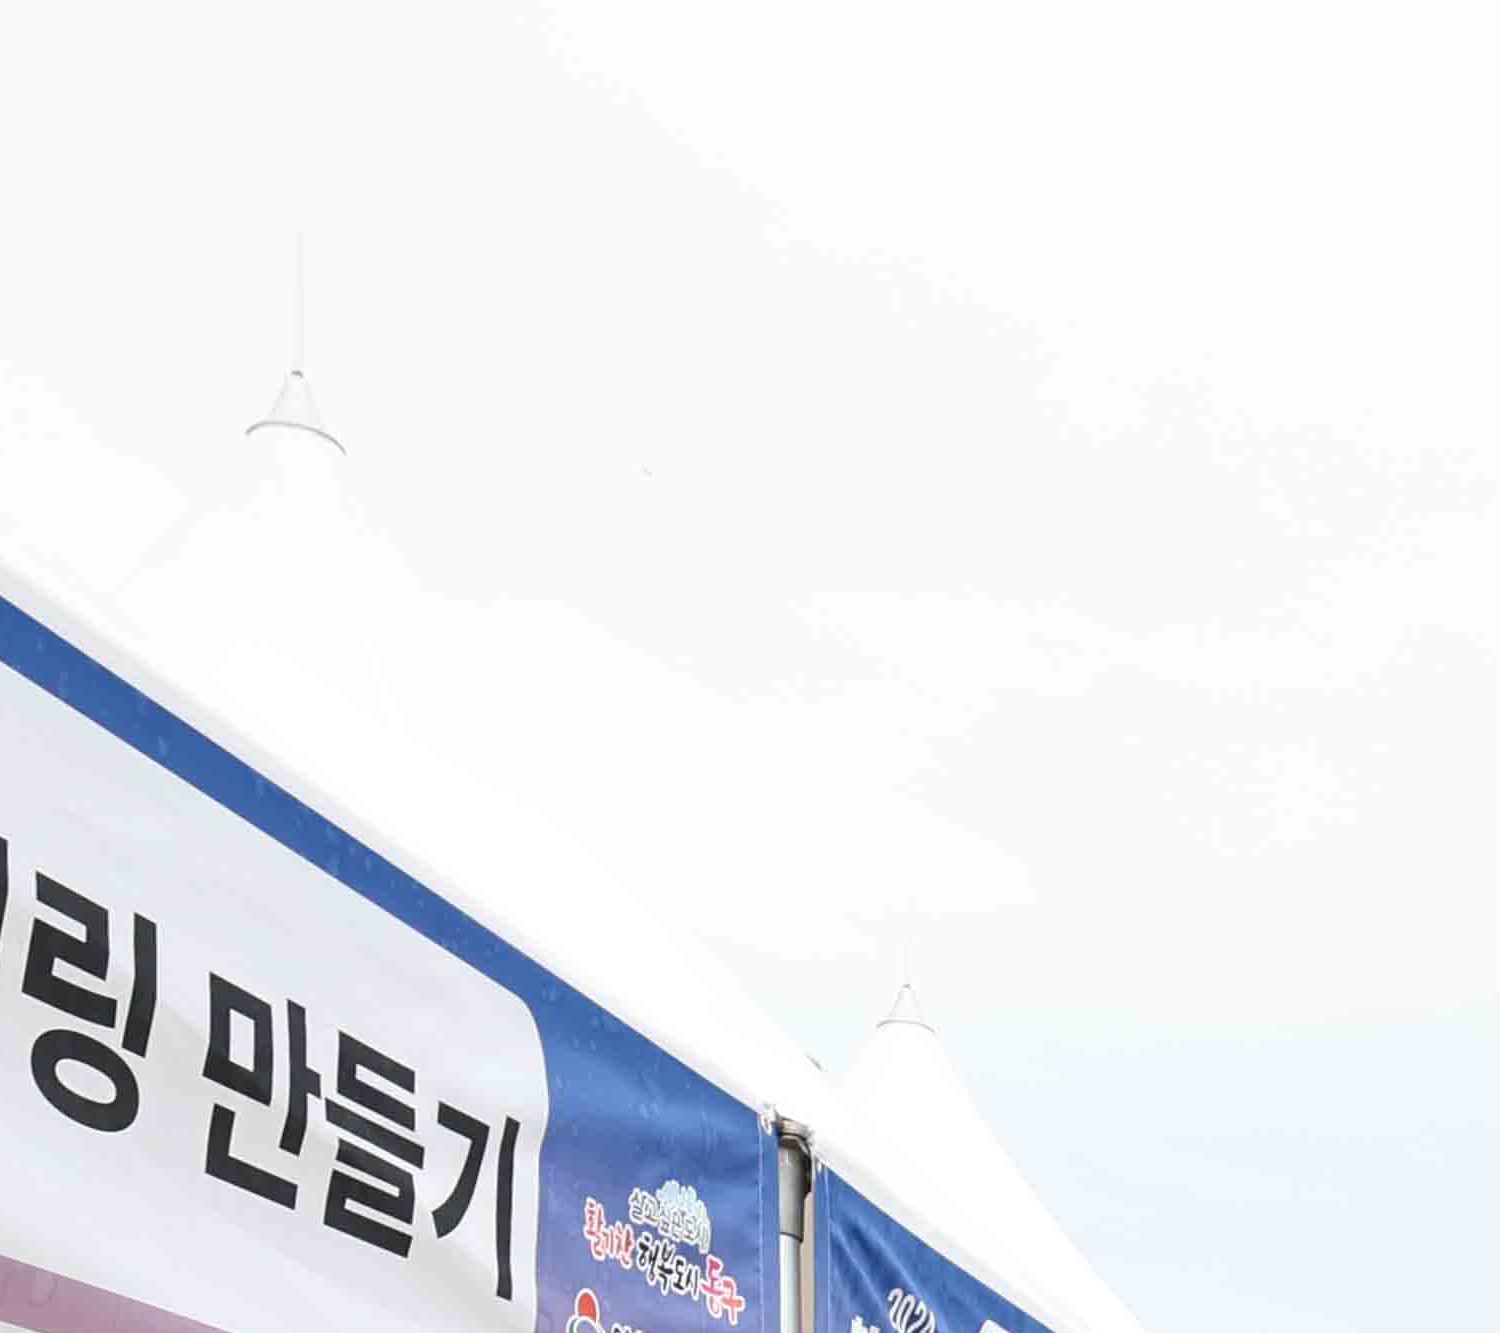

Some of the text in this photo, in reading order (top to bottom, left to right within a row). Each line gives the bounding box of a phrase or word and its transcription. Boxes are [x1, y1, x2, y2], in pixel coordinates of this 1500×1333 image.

[202, 971, 520, 1301] 만들기
[636, 1232, 700, 1301] 행복도시
[700, 1255, 745, 1325] 동구
